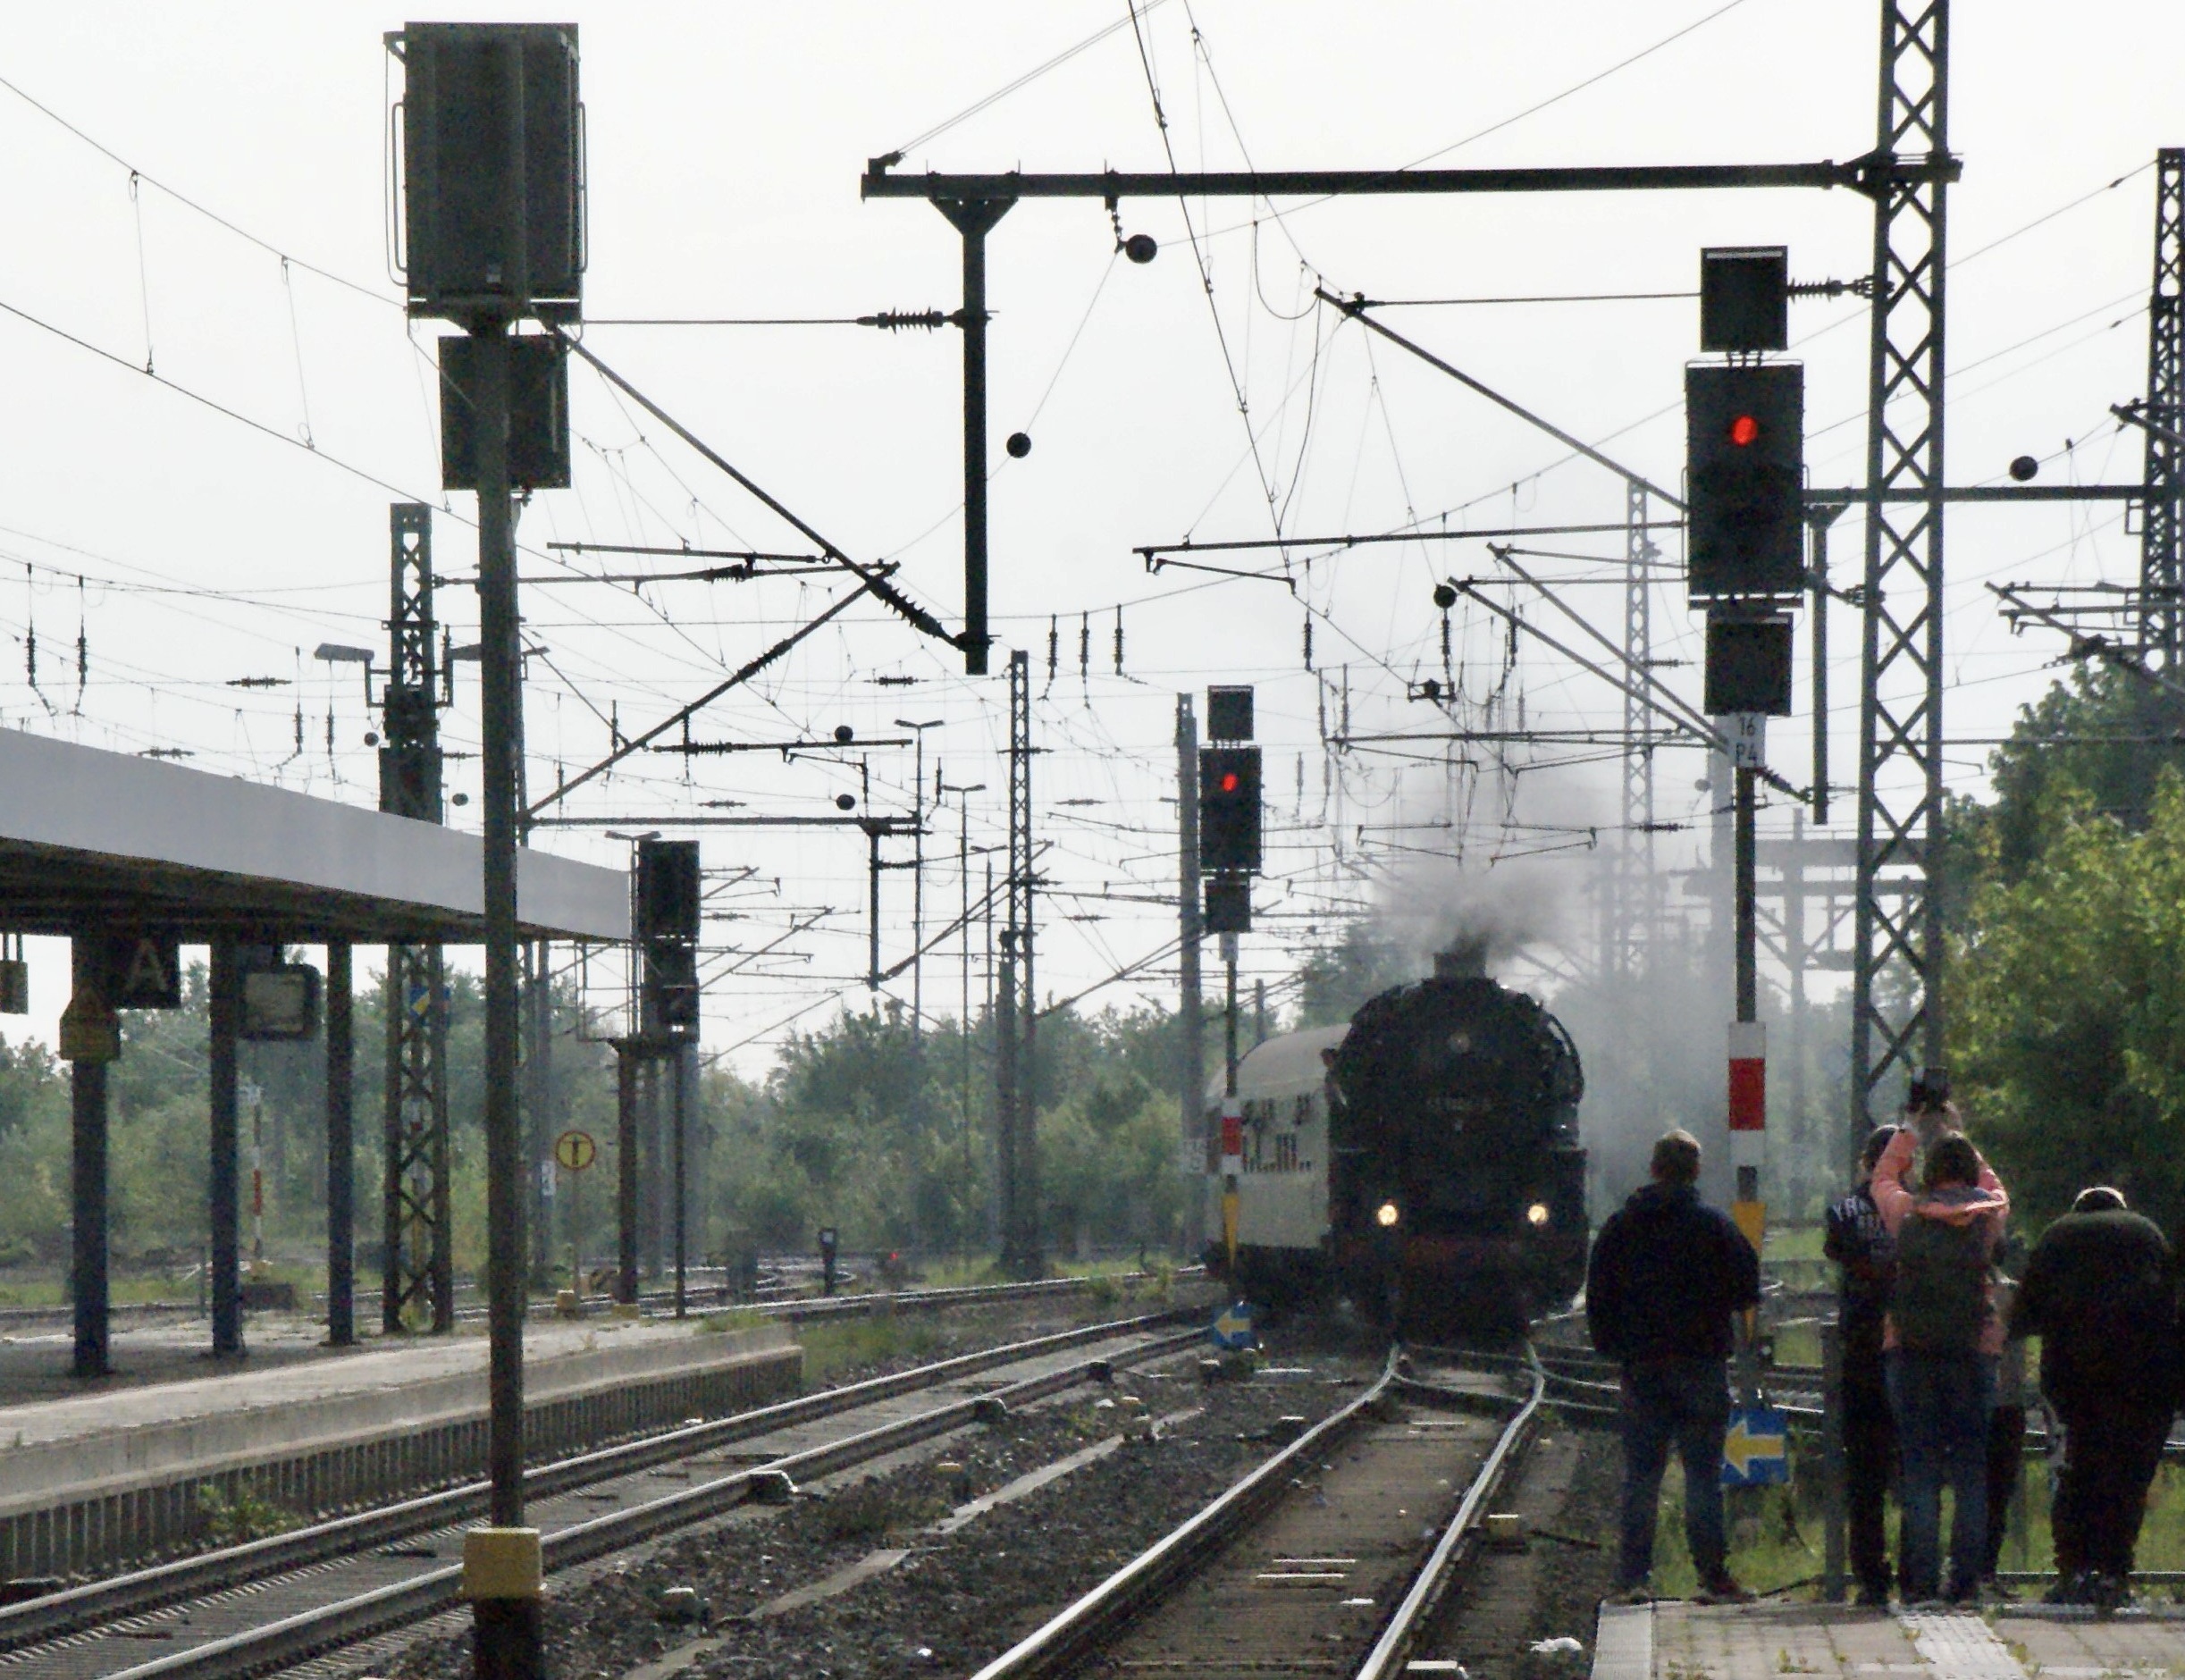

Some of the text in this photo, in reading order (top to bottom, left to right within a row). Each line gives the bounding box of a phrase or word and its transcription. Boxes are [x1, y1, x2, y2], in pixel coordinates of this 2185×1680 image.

[1738, 717, 1756, 736] 16
[1735, 743, 1758, 767] P4
[123, 938, 167, 994] A
